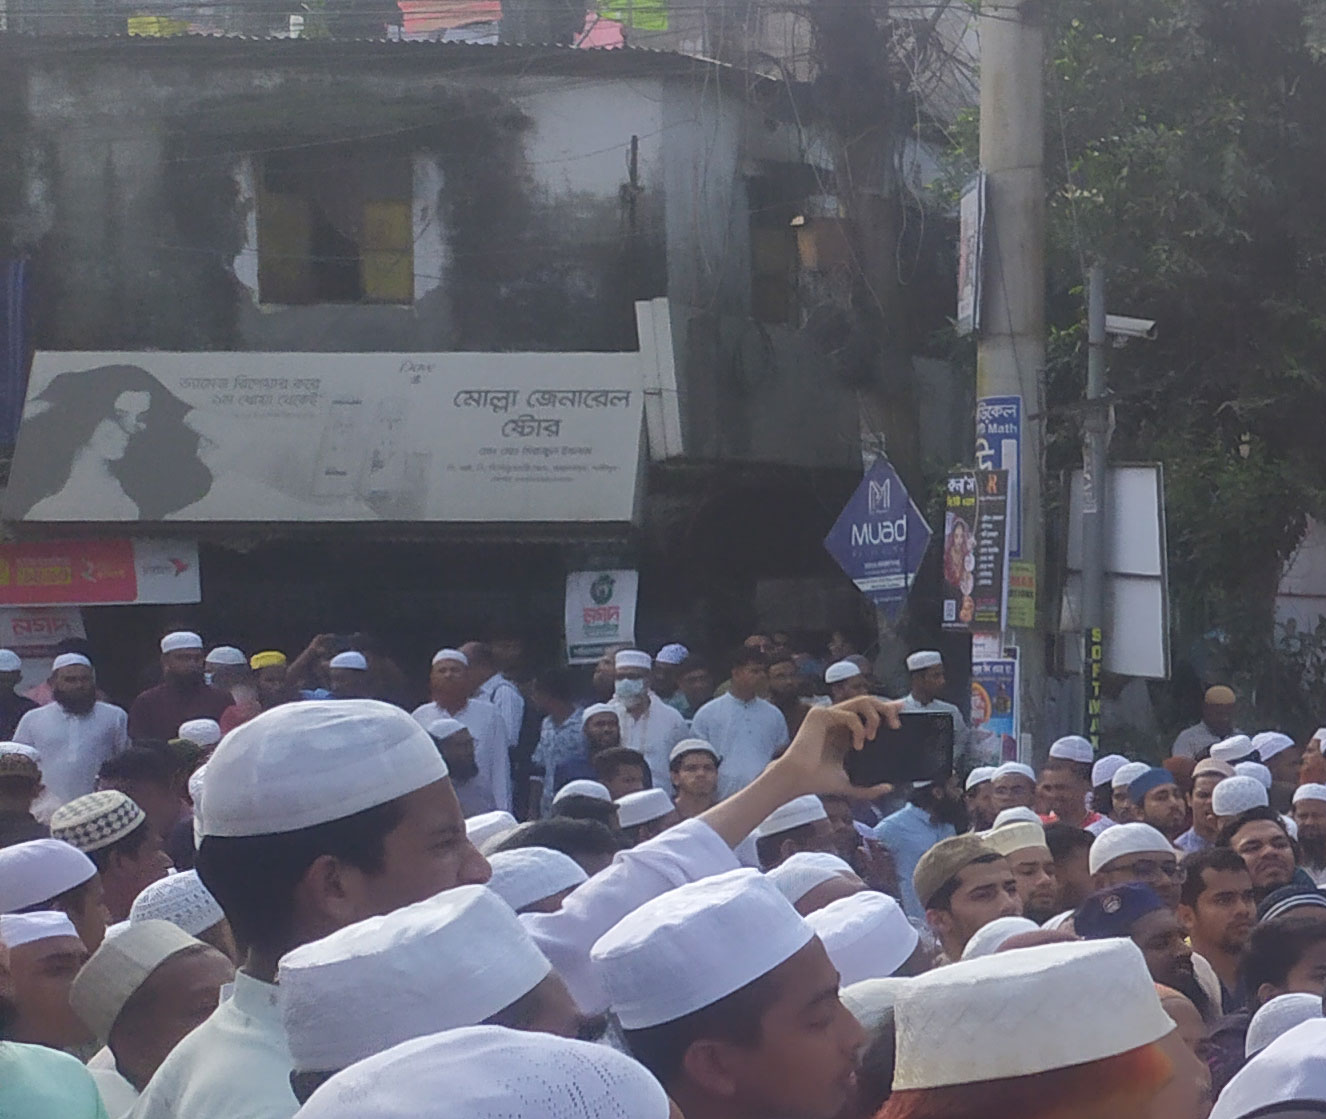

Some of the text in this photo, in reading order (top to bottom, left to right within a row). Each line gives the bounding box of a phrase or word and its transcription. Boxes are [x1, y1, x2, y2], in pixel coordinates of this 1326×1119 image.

[453, 390, 632, 413] মোল্লা জেনারেল
[988, 423, 1018, 434] Math
